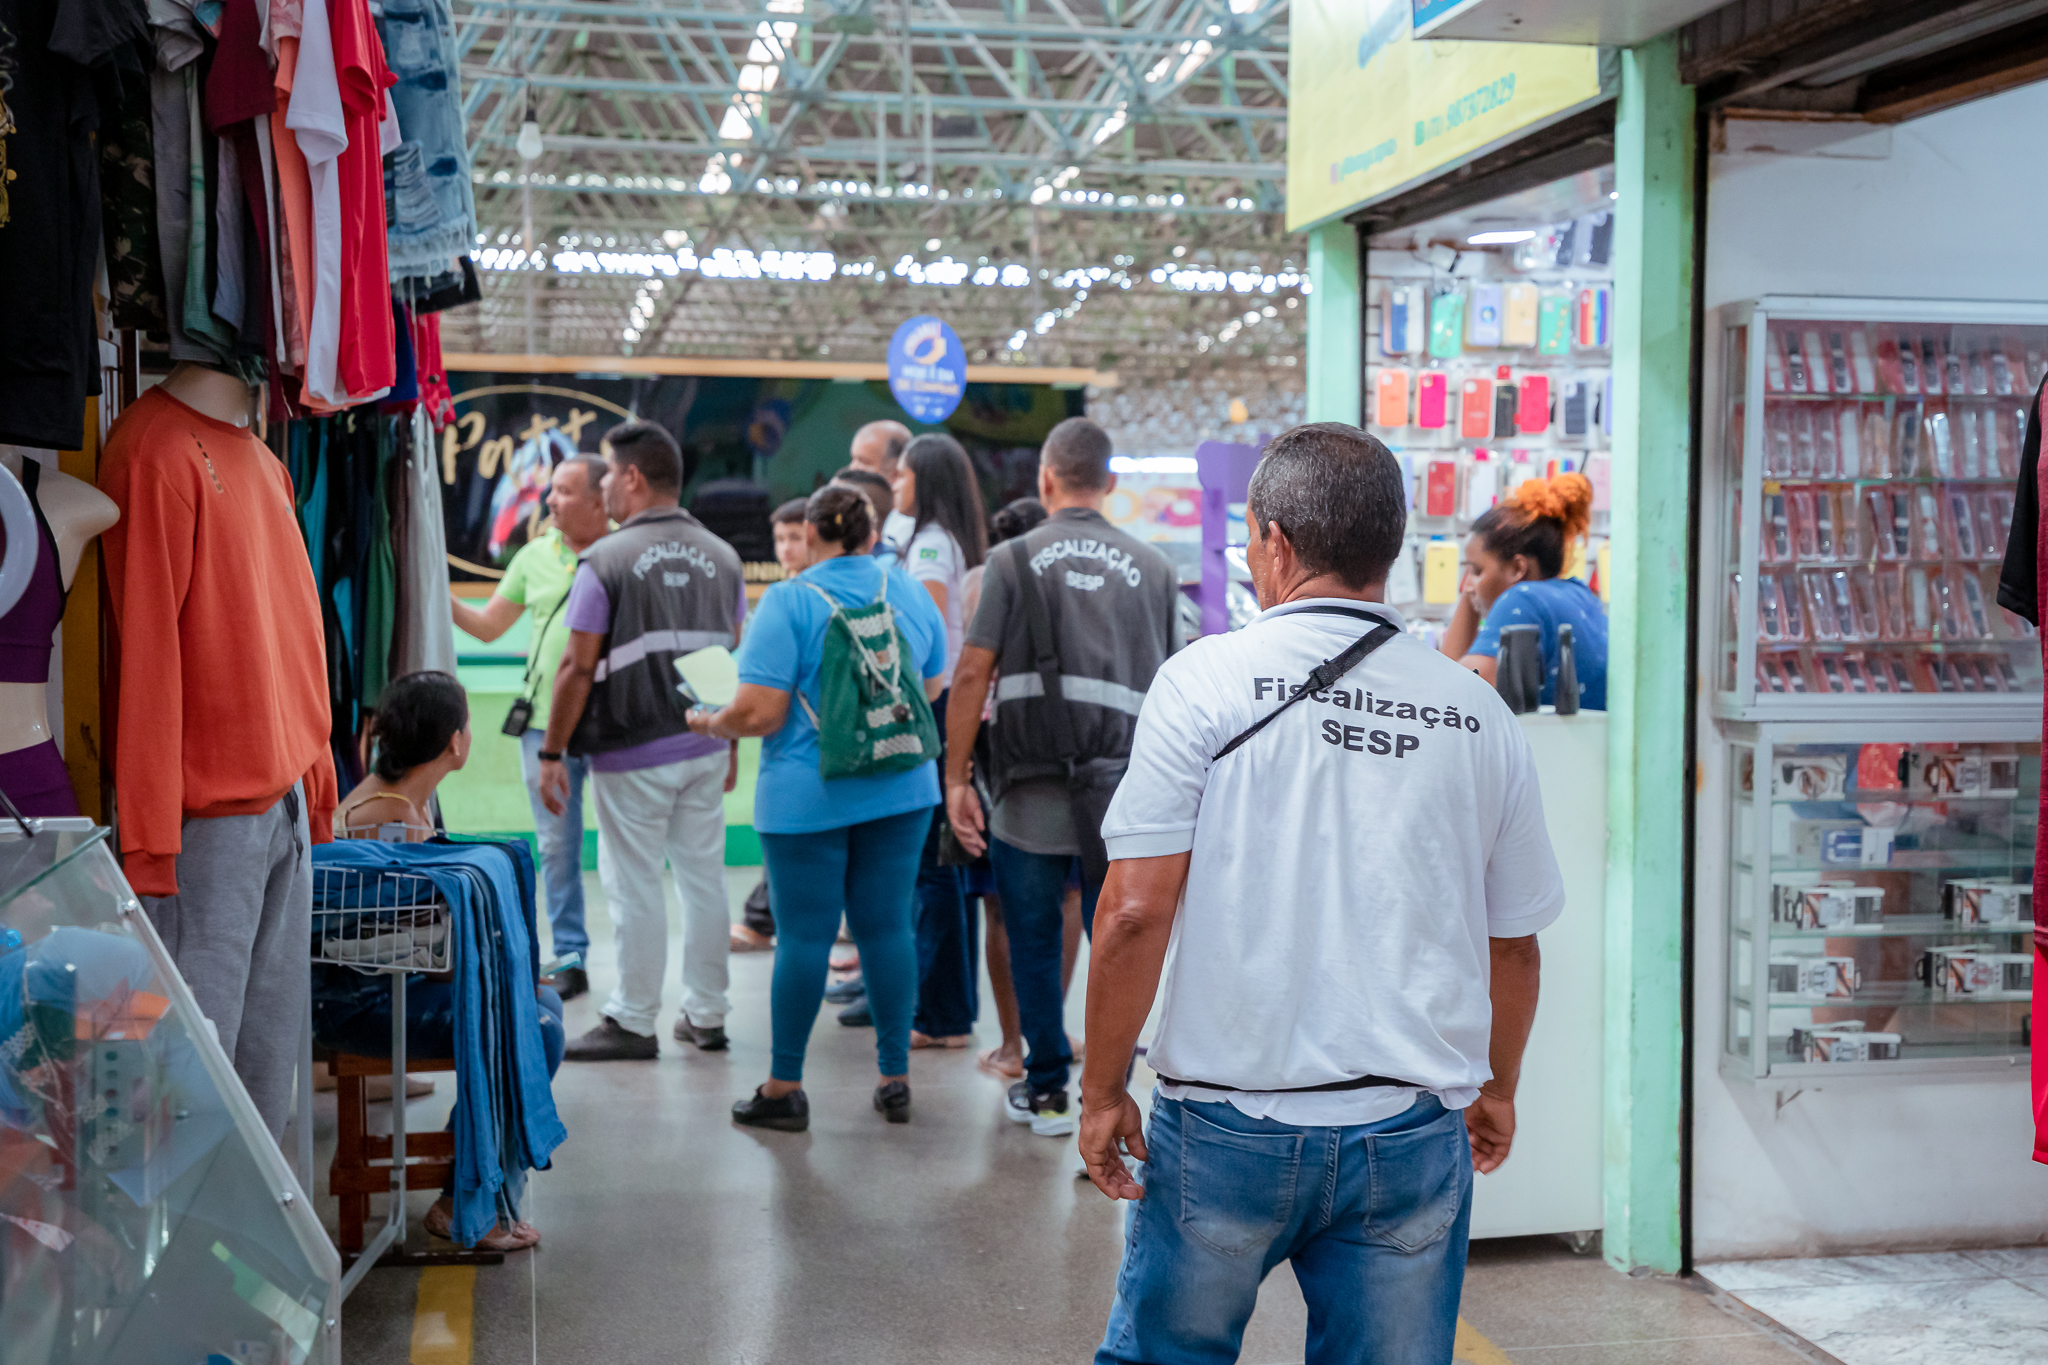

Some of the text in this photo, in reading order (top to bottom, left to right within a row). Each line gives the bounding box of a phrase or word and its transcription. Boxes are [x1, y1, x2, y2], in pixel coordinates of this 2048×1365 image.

[1029, 538, 1142, 588] FISCALIZAÇÃO
[1065, 569, 1105, 592] SESP
[1253, 677, 1481, 734] Fiscalização
[1321, 718, 1420, 759] SESP
